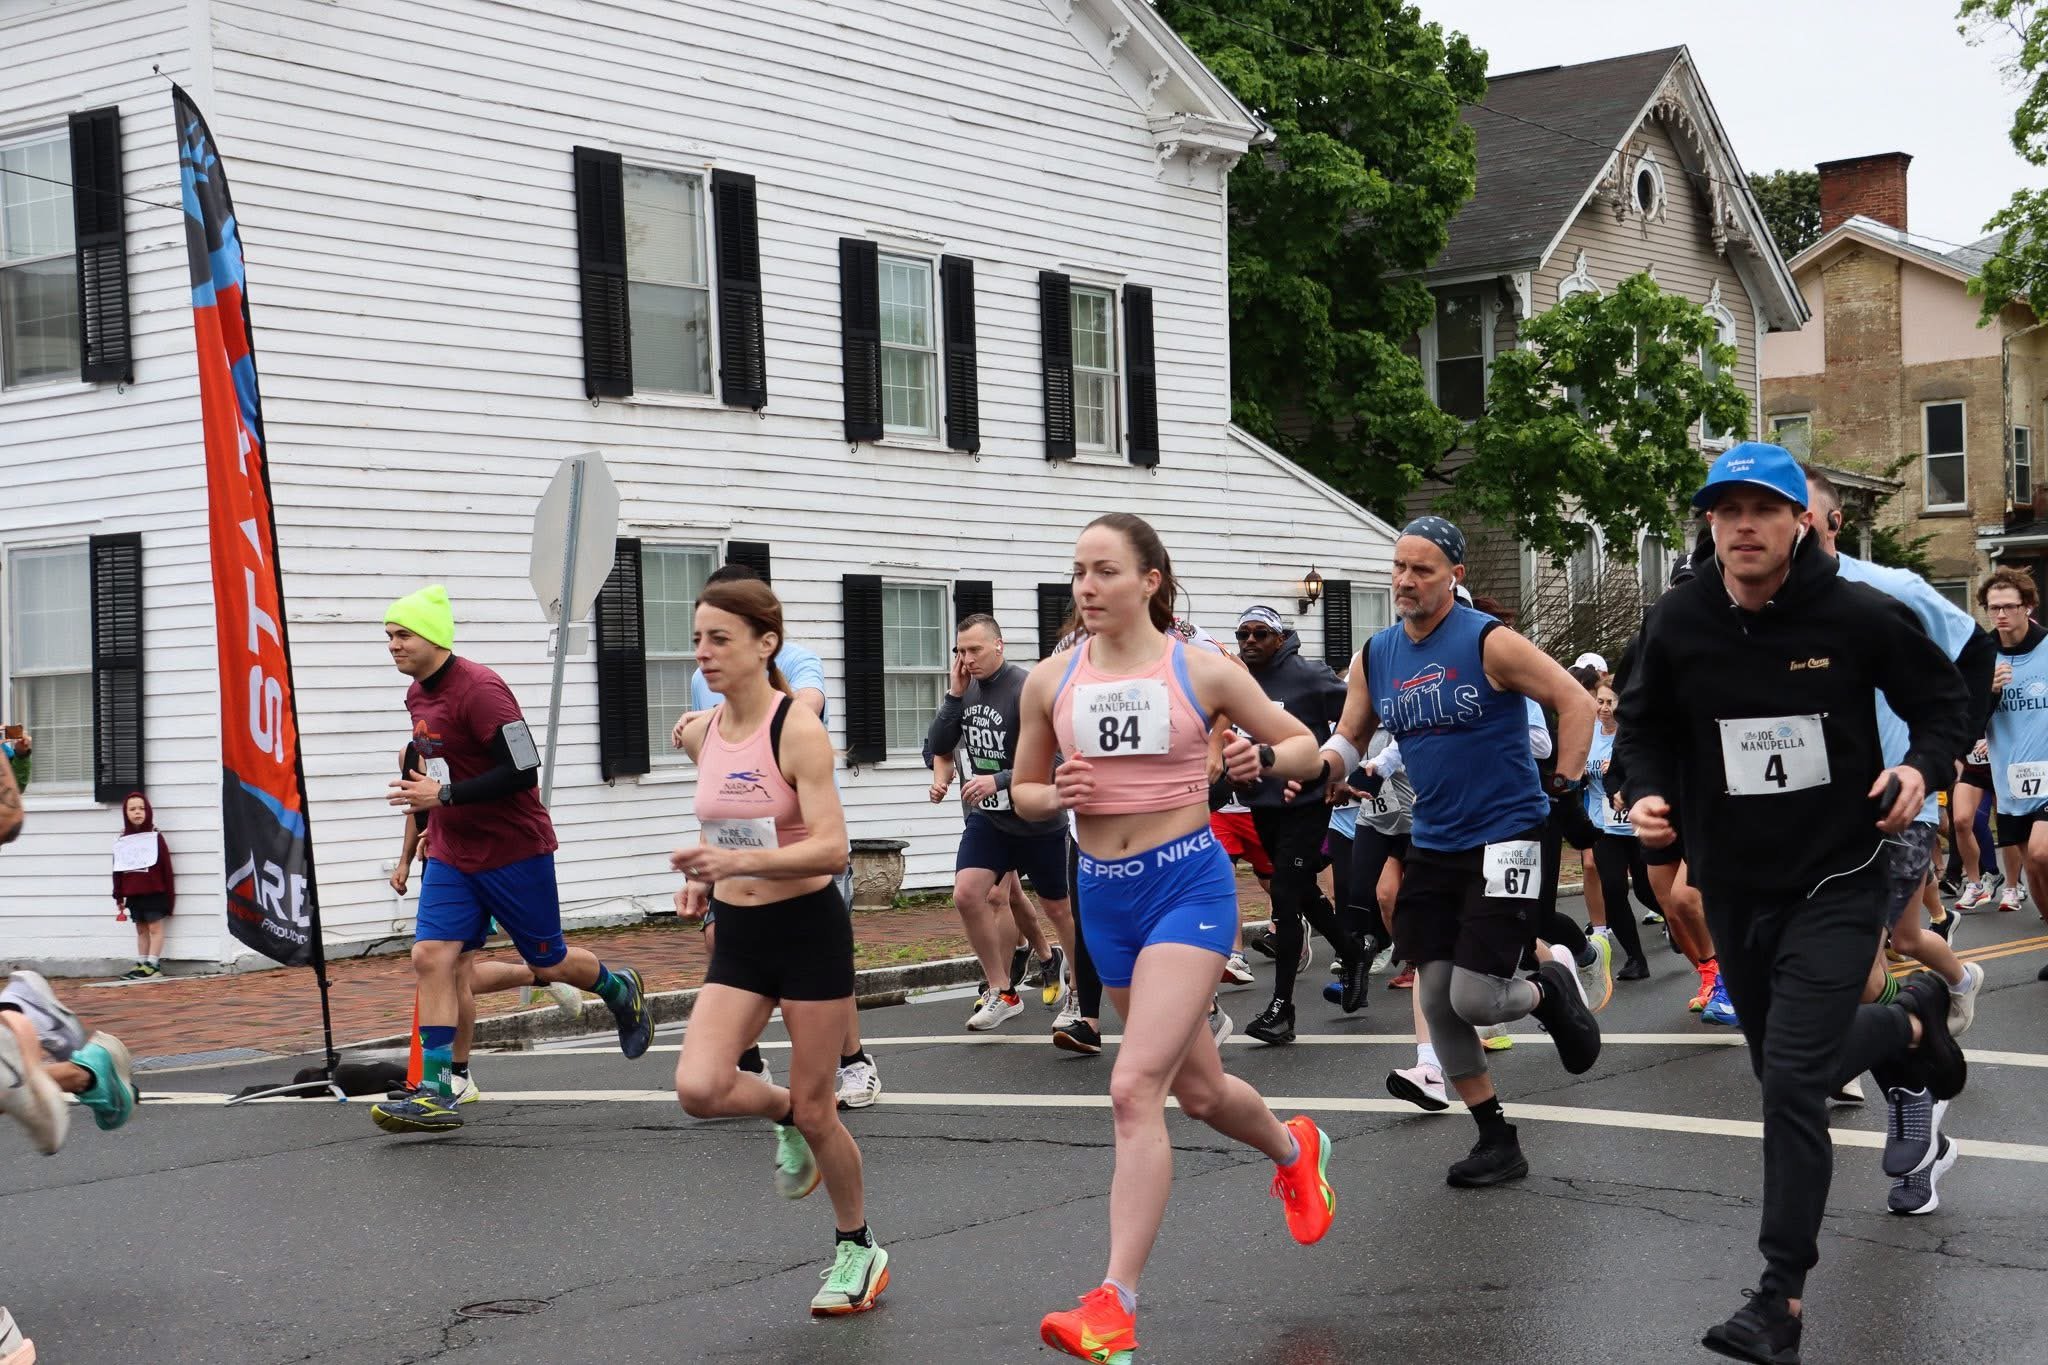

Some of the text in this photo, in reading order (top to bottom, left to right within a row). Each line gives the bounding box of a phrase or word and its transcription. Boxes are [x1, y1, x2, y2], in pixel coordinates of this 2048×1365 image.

[1107, 692, 1123, 702] JOE
[1090, 701, 1151, 713] MANUPELLA
[1381, 684, 1483, 733] BILLS
[962, 704, 1003, 726] JUST A KID
[972, 716, 990, 728] FROM
[1099, 715, 1141, 751] 84
[1757, 730, 1774, 741] JOE
[1741, 738, 1805, 752] MANUPELLA
[983, 748, 1007, 760] YORK
[1765, 754, 1788, 788] 4
[2021, 779, 2042, 796] 47
[1369, 797, 1388, 814] 78
[1613, 809, 1632, 824] 42
[728, 828, 741, 838] JOE
[717, 835, 764, 848] MANUPELLA
[1157, 831, 1212, 868] NIKE
[1511, 850, 1524, 858] JOE
[1497, 857, 1537, 866] MANUPELLA
[1095, 860, 1145, 880] PRO
[1505, 867, 1531, 895] 67
